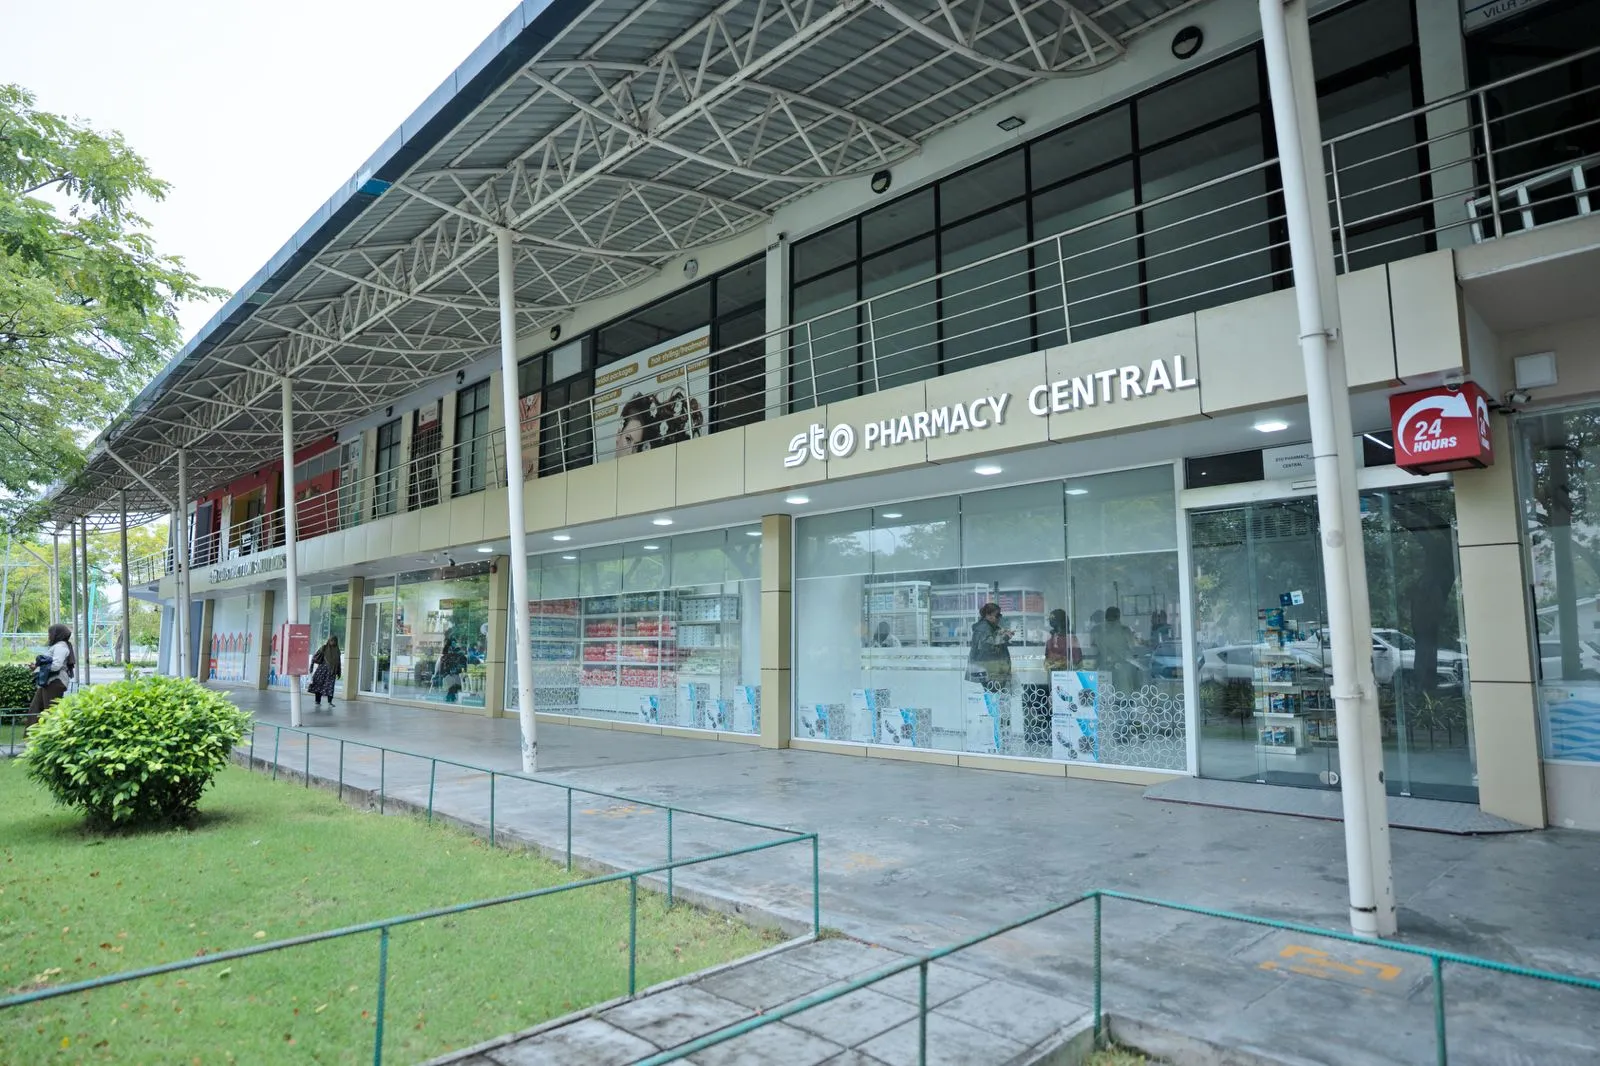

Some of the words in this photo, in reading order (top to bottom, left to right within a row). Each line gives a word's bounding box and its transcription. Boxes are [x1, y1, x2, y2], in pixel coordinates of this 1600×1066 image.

[1483, 0, 1517, 18] VILLA
[865, 393, 1011, 450] PHARMACY
[1028, 354, 1197, 417] CENTRAL
[1414, 418, 1442, 441] 24
[1413, 436, 1458, 453] HOURS
